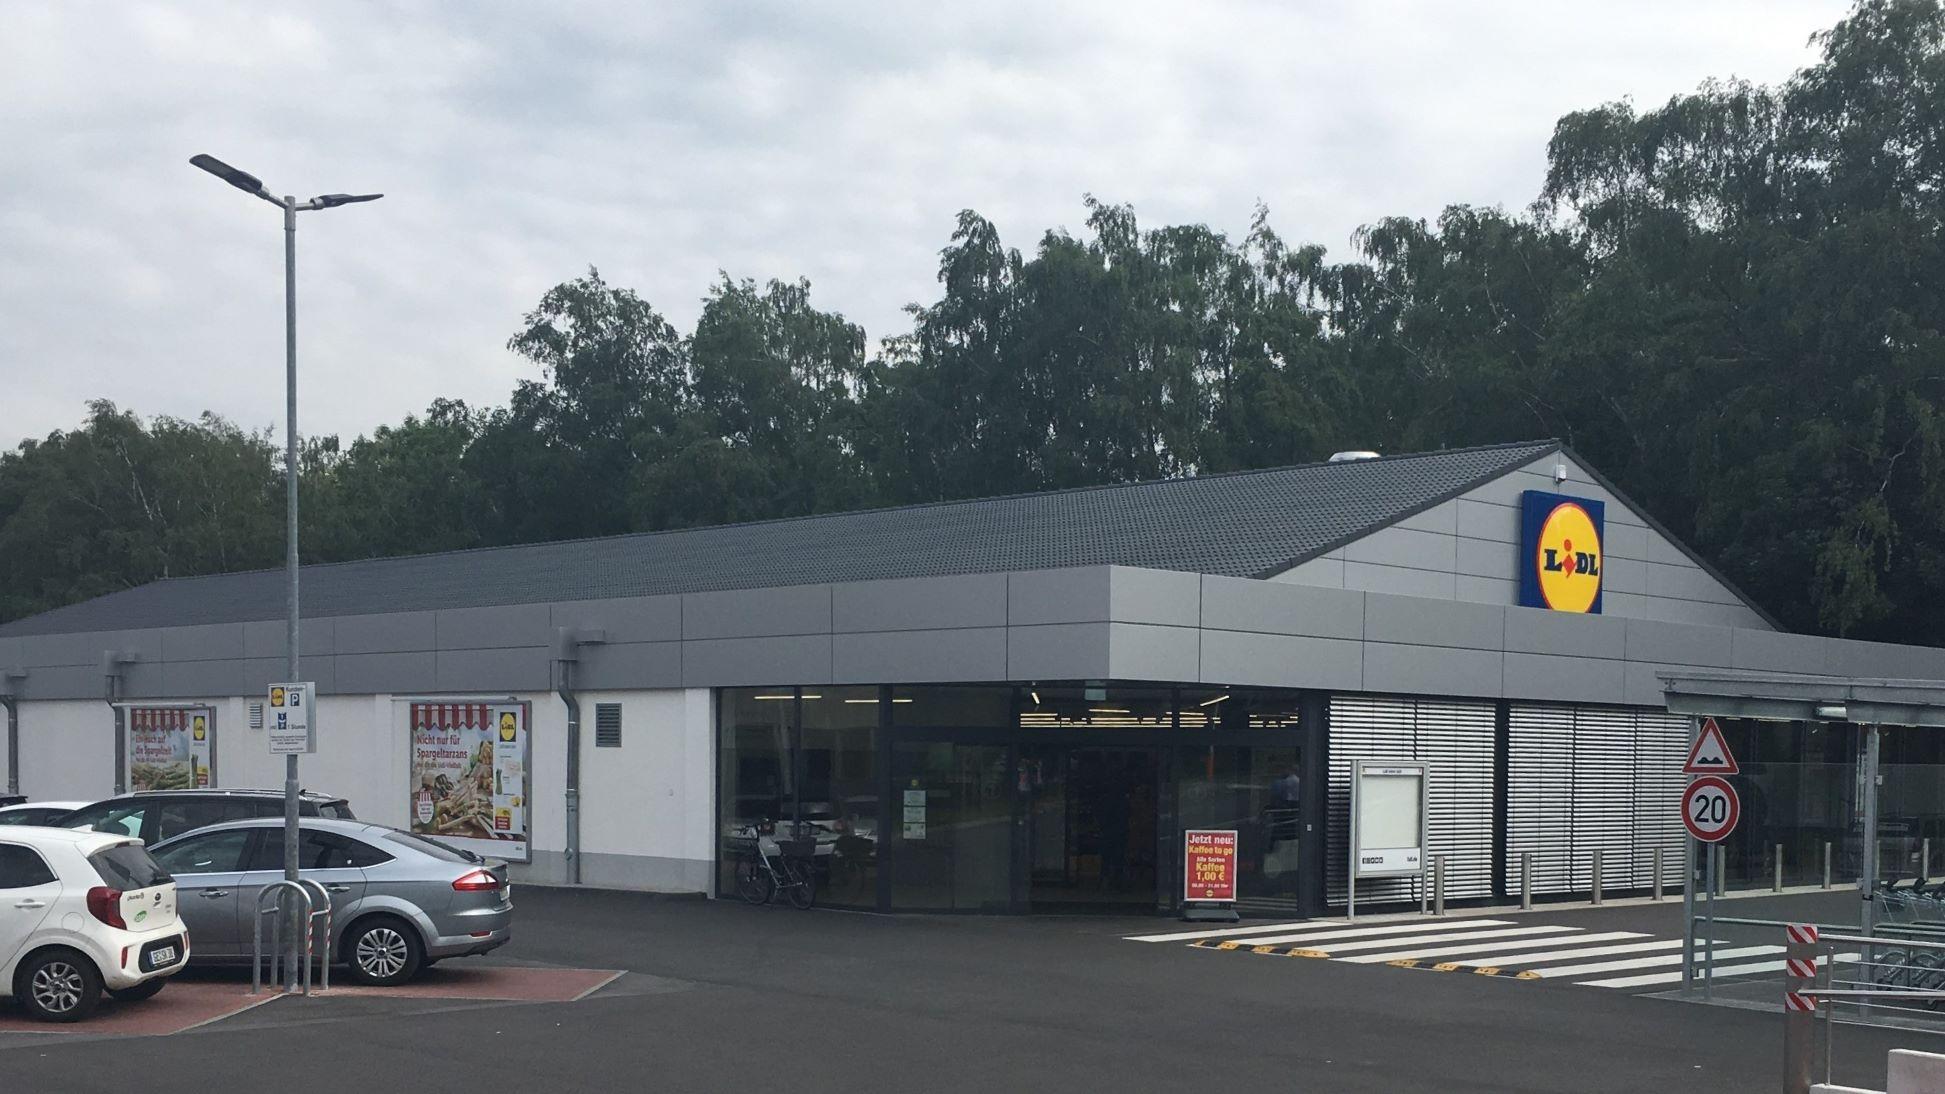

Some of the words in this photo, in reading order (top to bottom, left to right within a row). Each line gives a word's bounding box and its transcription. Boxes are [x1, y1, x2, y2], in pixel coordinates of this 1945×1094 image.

[416, 734, 436, 745] Nicht
[436, 737, 448, 745] nur
[449, 734, 461, 745] für
[416, 748, 468, 760] Spargeltarzans
[1694, 795, 1726, 823] 20
[1189, 835, 1211, 844] Jetzt
[1214, 836, 1234, 844] neu:
[1189, 846, 1213, 854] Kaffee
[1223, 848, 1233, 856] go
[1196, 862, 1225, 871] Kaffee
[1196, 871, 1216, 882] 1,00
[1218, 871, 1225, 881] €
